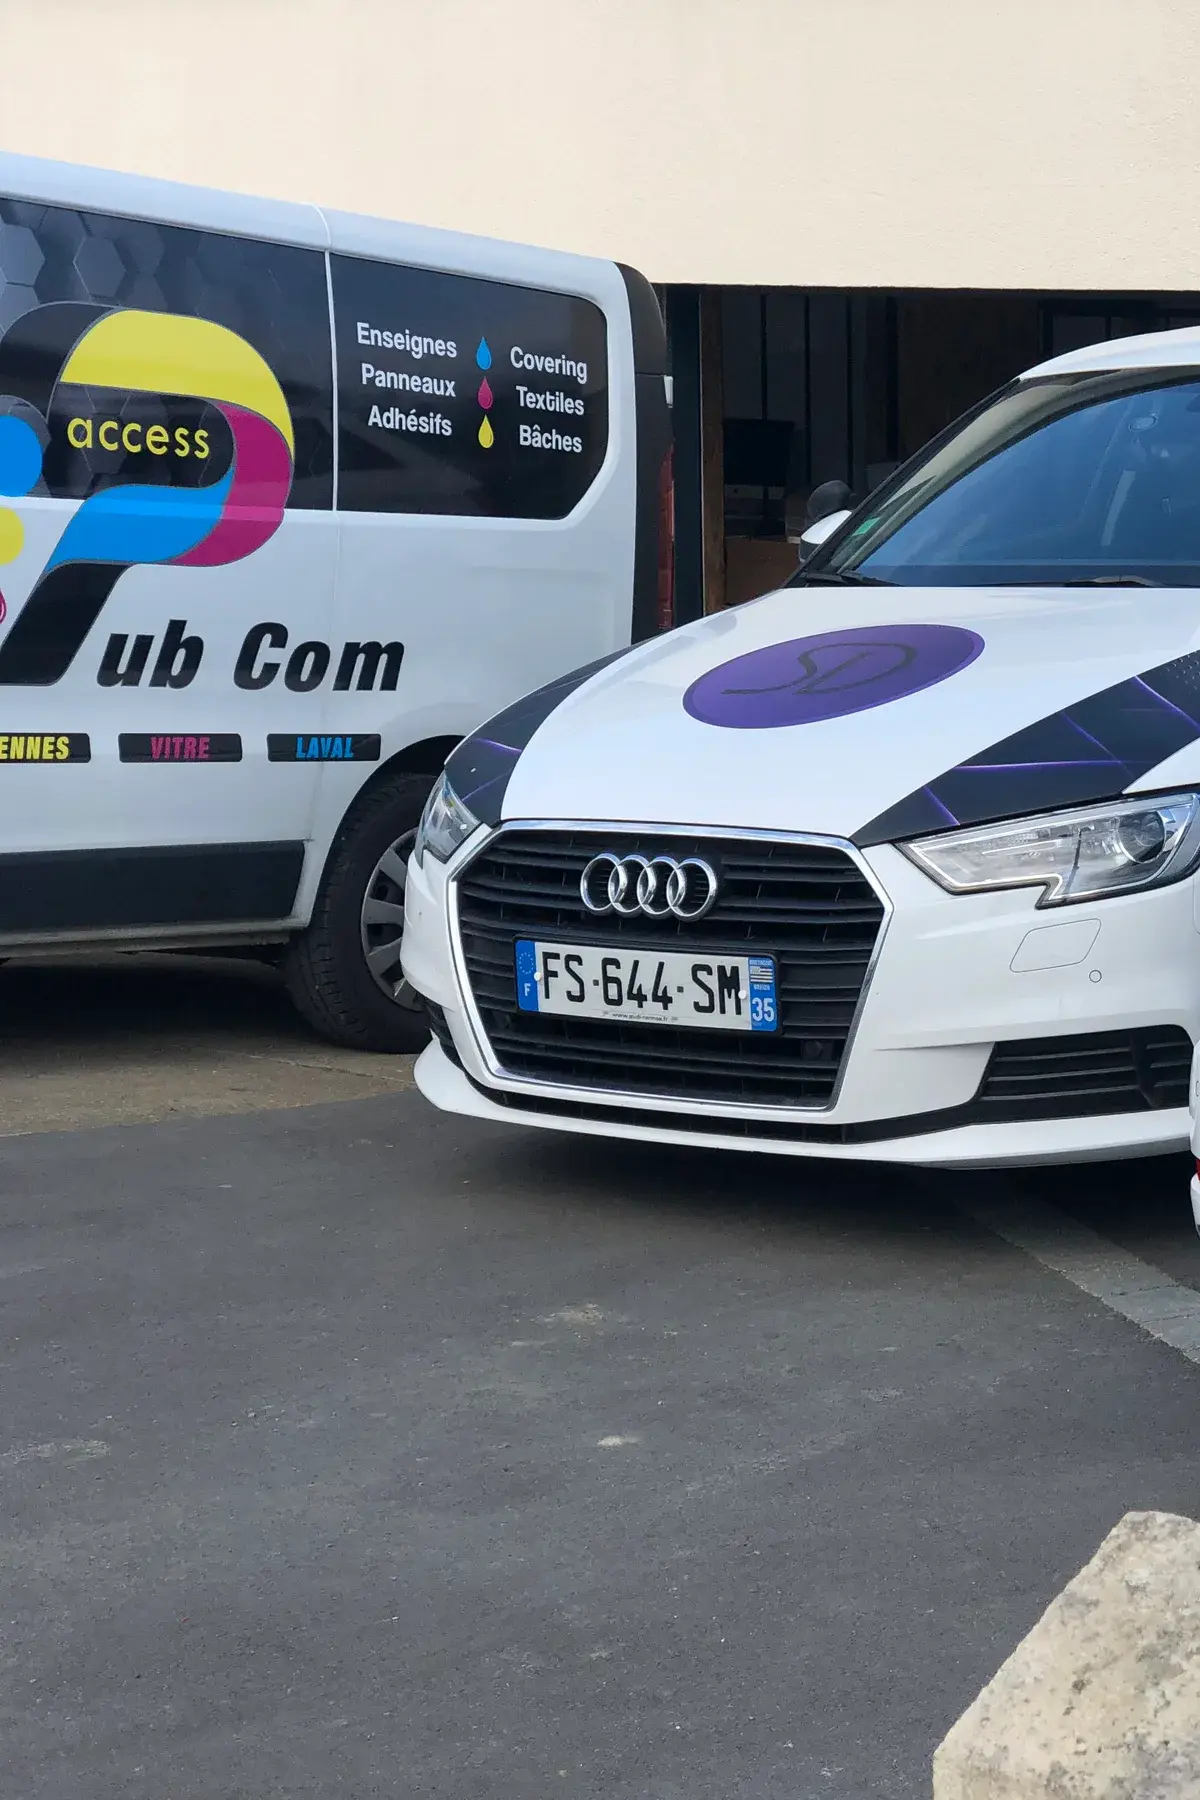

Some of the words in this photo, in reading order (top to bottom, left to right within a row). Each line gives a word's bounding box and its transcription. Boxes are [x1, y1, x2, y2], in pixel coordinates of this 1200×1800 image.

[357, 322, 457, 359] Enseignes
[361, 363, 456, 397] Panneaux
[510, 346, 588, 384] Covering
[516, 386, 584, 416] Textiles
[368, 405, 452, 436] Adhésifs
[67, 417, 210, 459] access
[519, 425, 582, 453] Bâches
[233, 622, 405, 692] Com
[151, 737, 210, 760] VITRE
[295, 737, 354, 760] LAVAL
[524, 983, 531, 996] F
[752, 997, 775, 1022] 35
